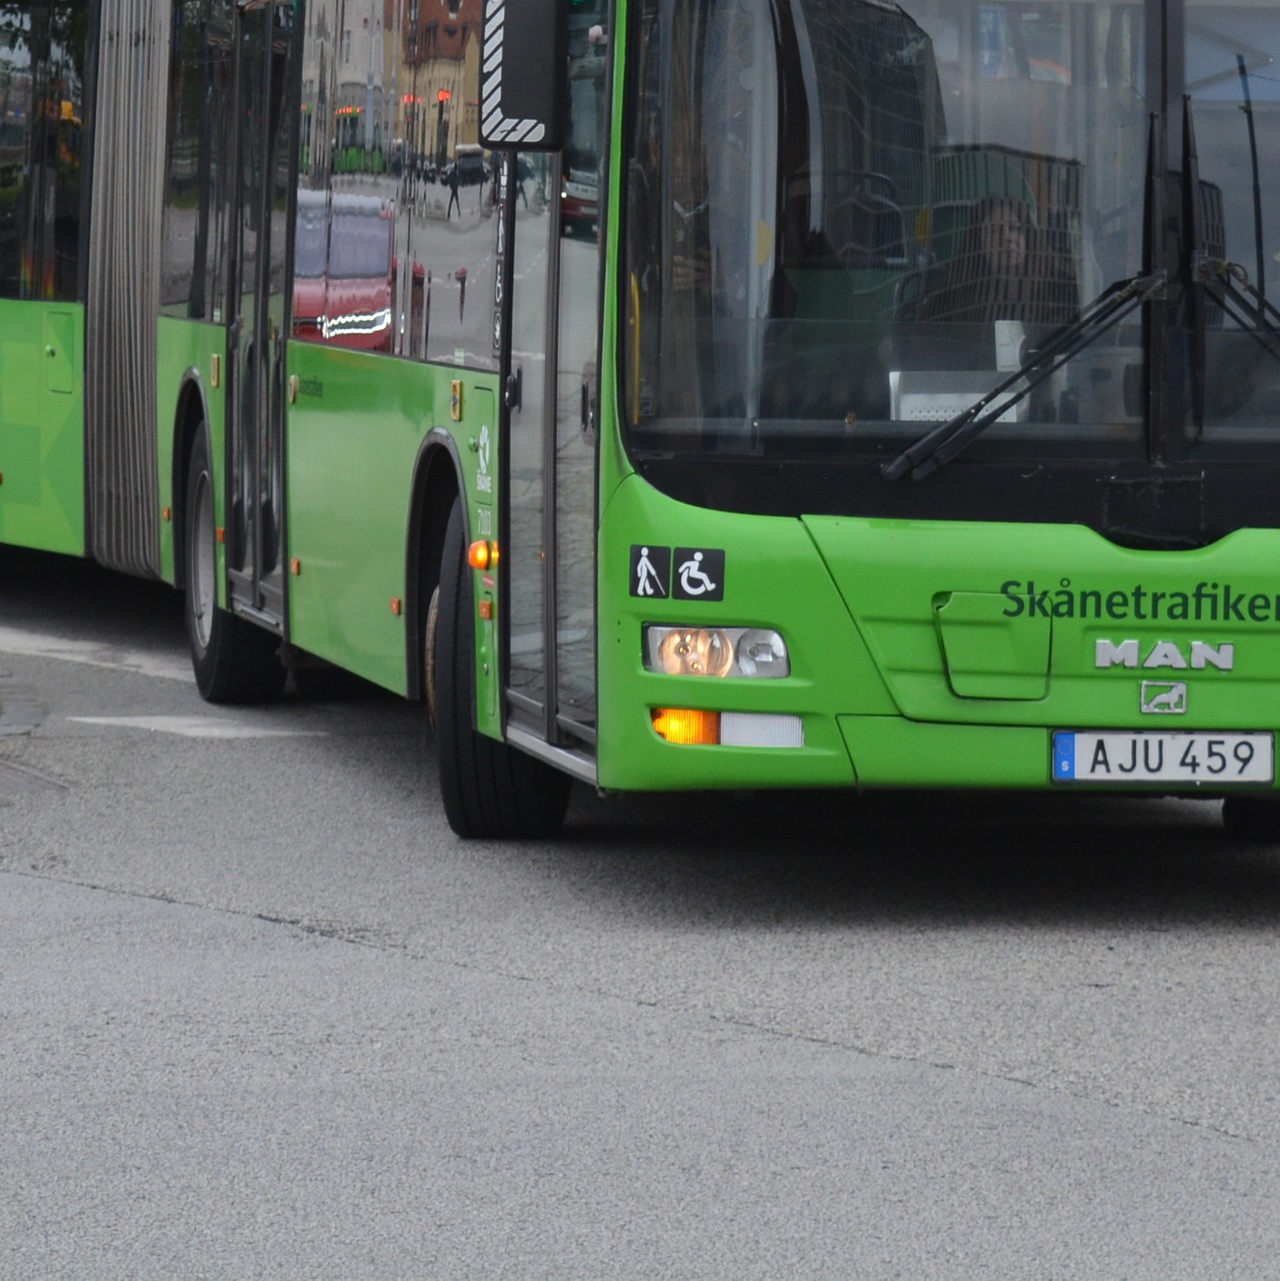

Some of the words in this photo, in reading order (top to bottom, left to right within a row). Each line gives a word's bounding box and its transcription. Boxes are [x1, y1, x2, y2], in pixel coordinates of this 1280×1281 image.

[1094, 638, 1235, 671] MAN
[1061, 759, 1070, 771] S
[1090, 738, 1164, 775] AJU
[1179, 738, 1256, 776] 459
